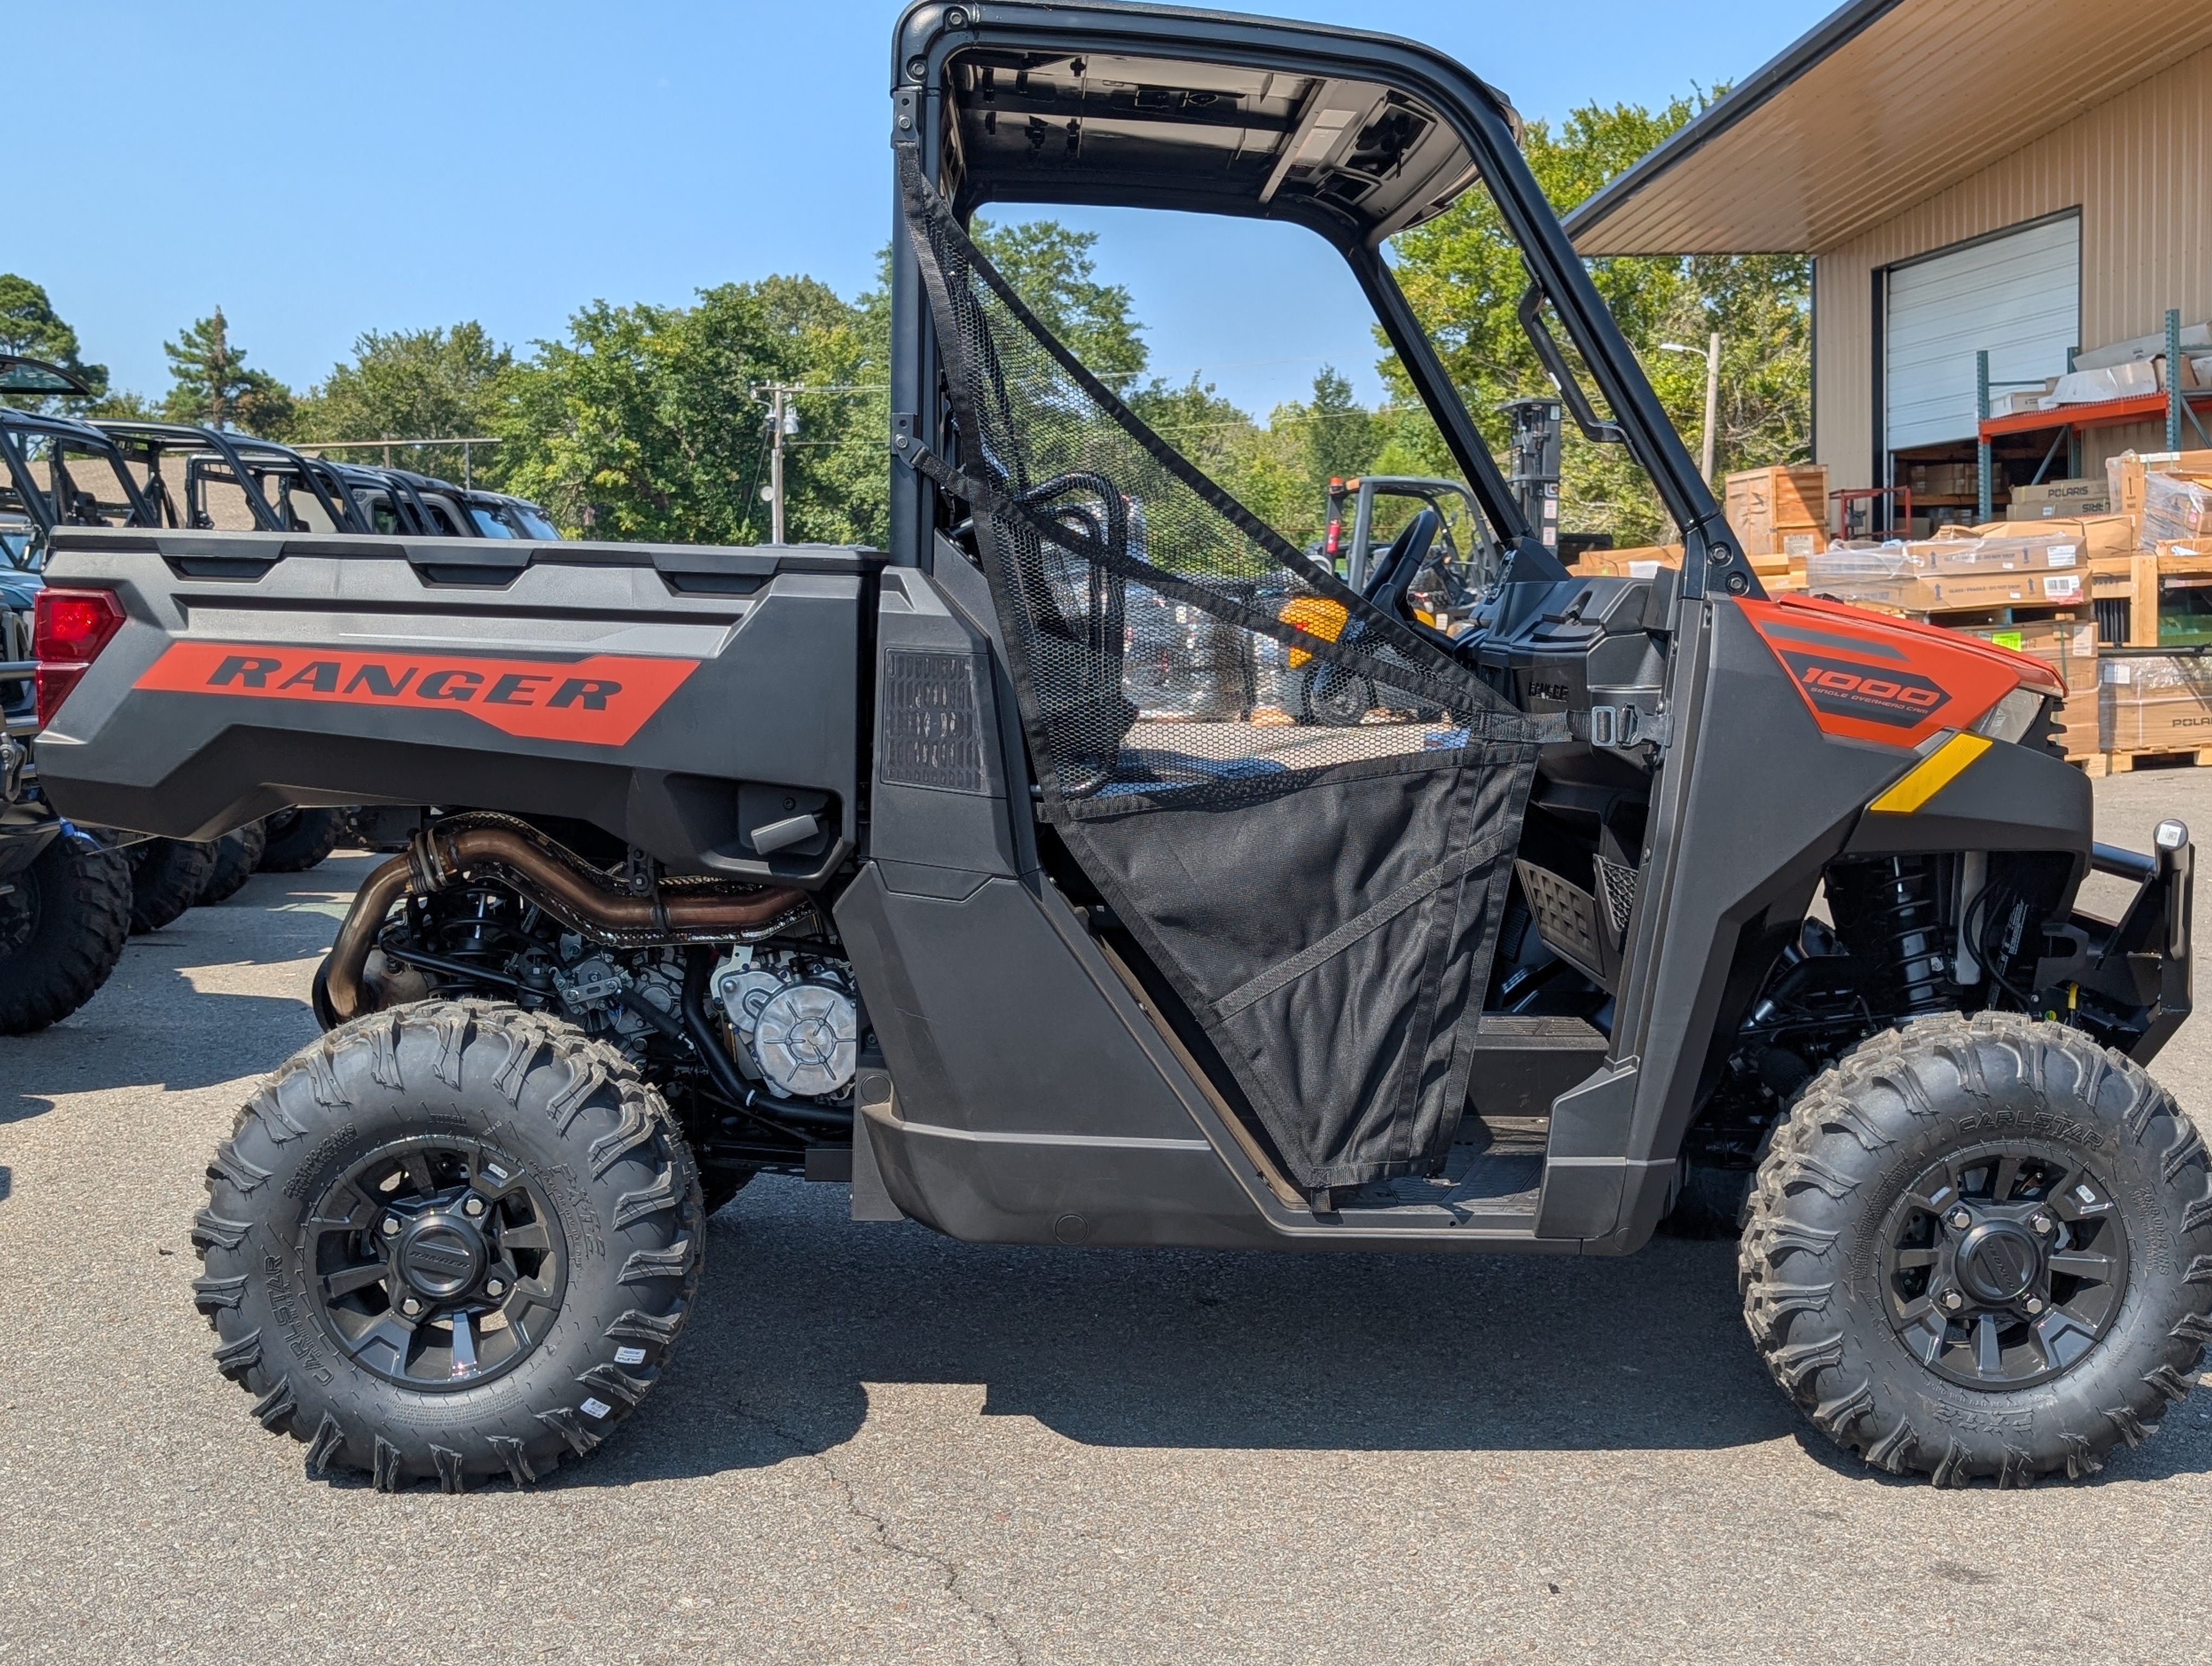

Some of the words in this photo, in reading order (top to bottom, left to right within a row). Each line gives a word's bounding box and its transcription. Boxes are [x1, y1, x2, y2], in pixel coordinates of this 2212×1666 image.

[2048, 485, 2088, 498] POLARIS
[206, 656, 623, 710] RANGER
[1802, 667, 1940, 707] 1000
[1810, 687, 1848, 698] SINGLE
[1851, 695, 1906, 712] OVERHEAD
[1906, 706, 1929, 715] CAM
[1958, 1110, 2105, 1151] CARLSTAR
[409, 1251, 470, 1269] RANGER
[264, 1256, 334, 1386] CARLSTAR
